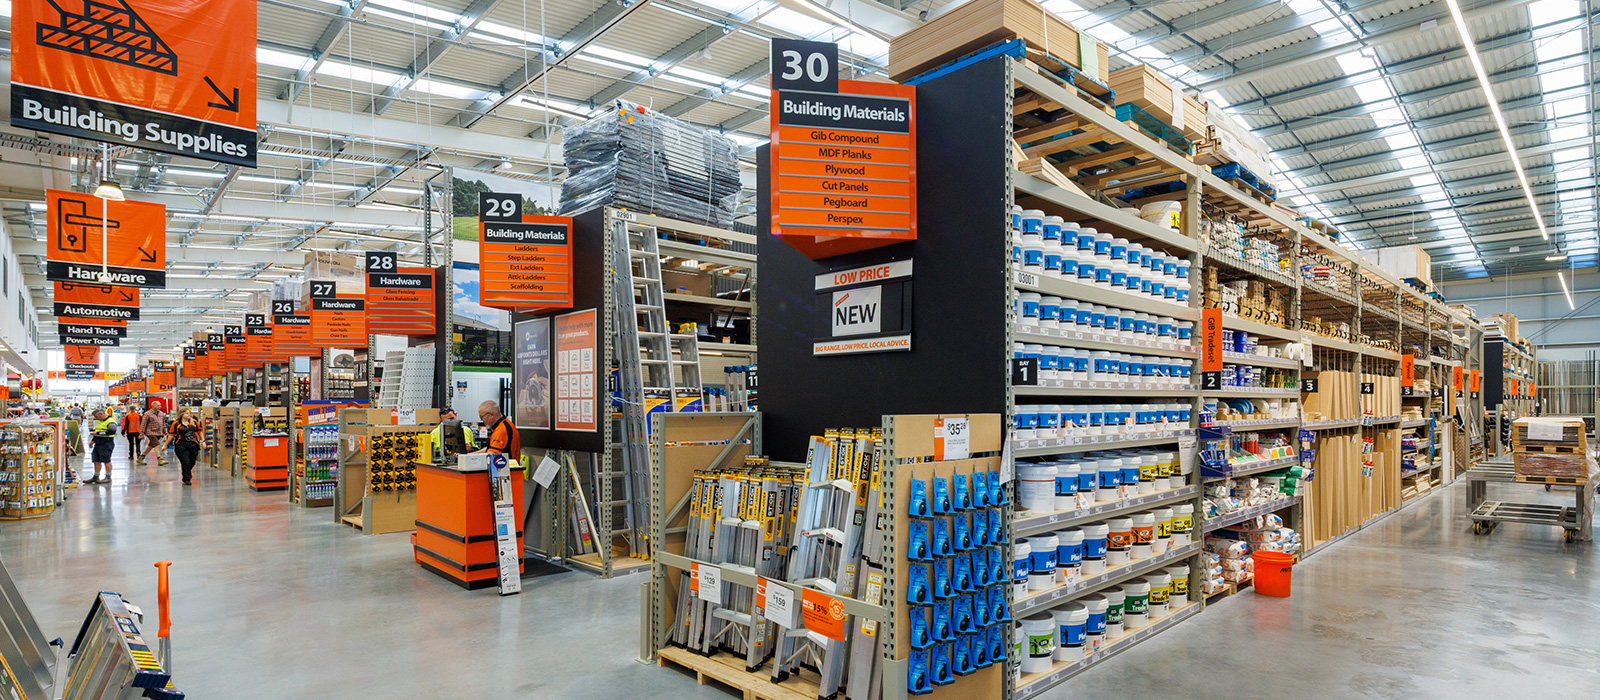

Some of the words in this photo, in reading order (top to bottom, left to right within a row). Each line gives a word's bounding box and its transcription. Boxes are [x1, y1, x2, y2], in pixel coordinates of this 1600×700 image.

[781, 50, 829, 83] 30
[783, 100, 841, 121] Building
[843, 104, 905, 122] Materials
[23, 99, 139, 142] Building
[145, 122, 248, 157] Supplies
[810, 131, 827, 141] Gib
[828, 132, 879, 144] Compound
[818, 148, 841, 158] MDF
[842, 149, 872, 160] Planks
[825, 164, 865, 176] Plywood
[822, 181, 839, 191] Cut
[840, 182, 869, 192] Panels
[485, 199, 517, 217] 29
[823, 197, 868, 208] Pegboard
[616, 211, 633, 220] 02901
[827, 213, 864, 225] Perspex
[487, 229, 524, 240] Building
[525, 230, 565, 240] Materials
[370, 256, 393, 270] 28
[380, 277, 421, 286] Hardware
[834, 271, 858, 286] LOW
[860, 266, 890, 282] PRICE
[1018, 272, 1035, 286] 03001
[313, 284, 332, 295] 27
[510, 283, 544, 291] Scaffolding
[275, 302, 292, 313] 26
[322, 301, 356, 309] Hardware
[63, 306, 131, 317] Automotive
[836, 303, 877, 326] NEW
[248, 316, 262, 325] 25
[1208, 317, 1216, 331] GIB
[67, 326, 93, 334] Hand
[94, 327, 118, 335] Tools
[226, 327, 239, 335] 24
[887, 339, 909, 347] ADVICE.
[1208, 331, 1216, 363] Tradeset
[1020, 367, 1028, 382] 1
[610, 381, 614, 389] 1
[748, 375, 758, 387] 11
[1207, 377, 1216, 387] 2
[308, 408, 321, 416] WIN
[321, 405, 336, 413] THIS
[861, 454, 869, 480] STOK
[1250, 533, 1265, 542] 150
[704, 575, 715, 585] $129
[773, 594, 786, 607] $159
[813, 603, 828, 616] 15%
